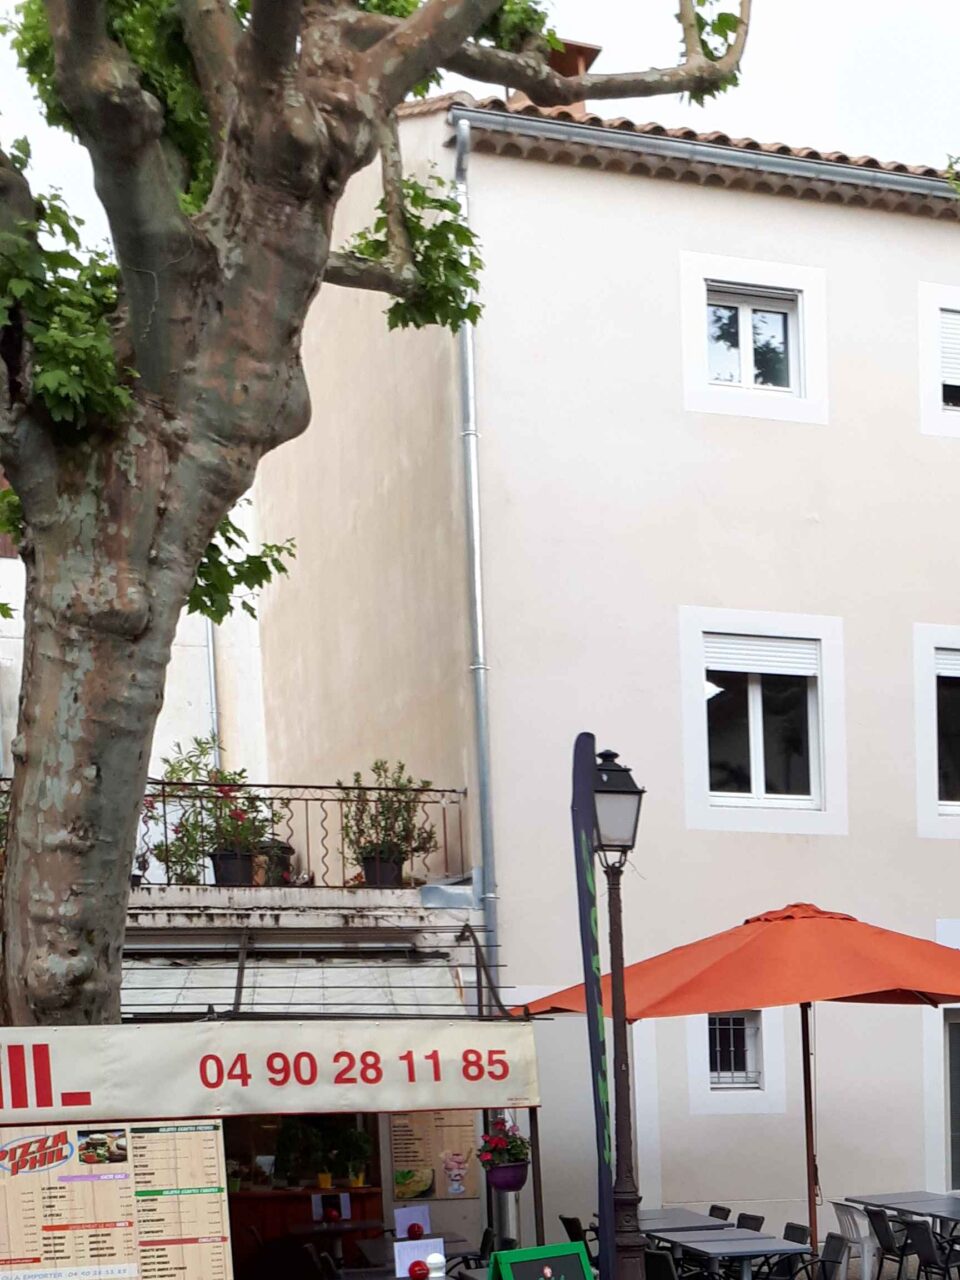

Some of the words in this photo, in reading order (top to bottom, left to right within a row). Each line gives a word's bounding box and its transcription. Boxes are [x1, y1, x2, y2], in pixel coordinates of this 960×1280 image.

[199, 1053, 252, 1088] 04
[266, 1051, 318, 1086] 90
[333, 1051, 384, 1084] 28
[399, 1050, 443, 1082] 11
[461, 1049, 510, 1081] 85
[10, 1147, 68, 1176] PHIL
